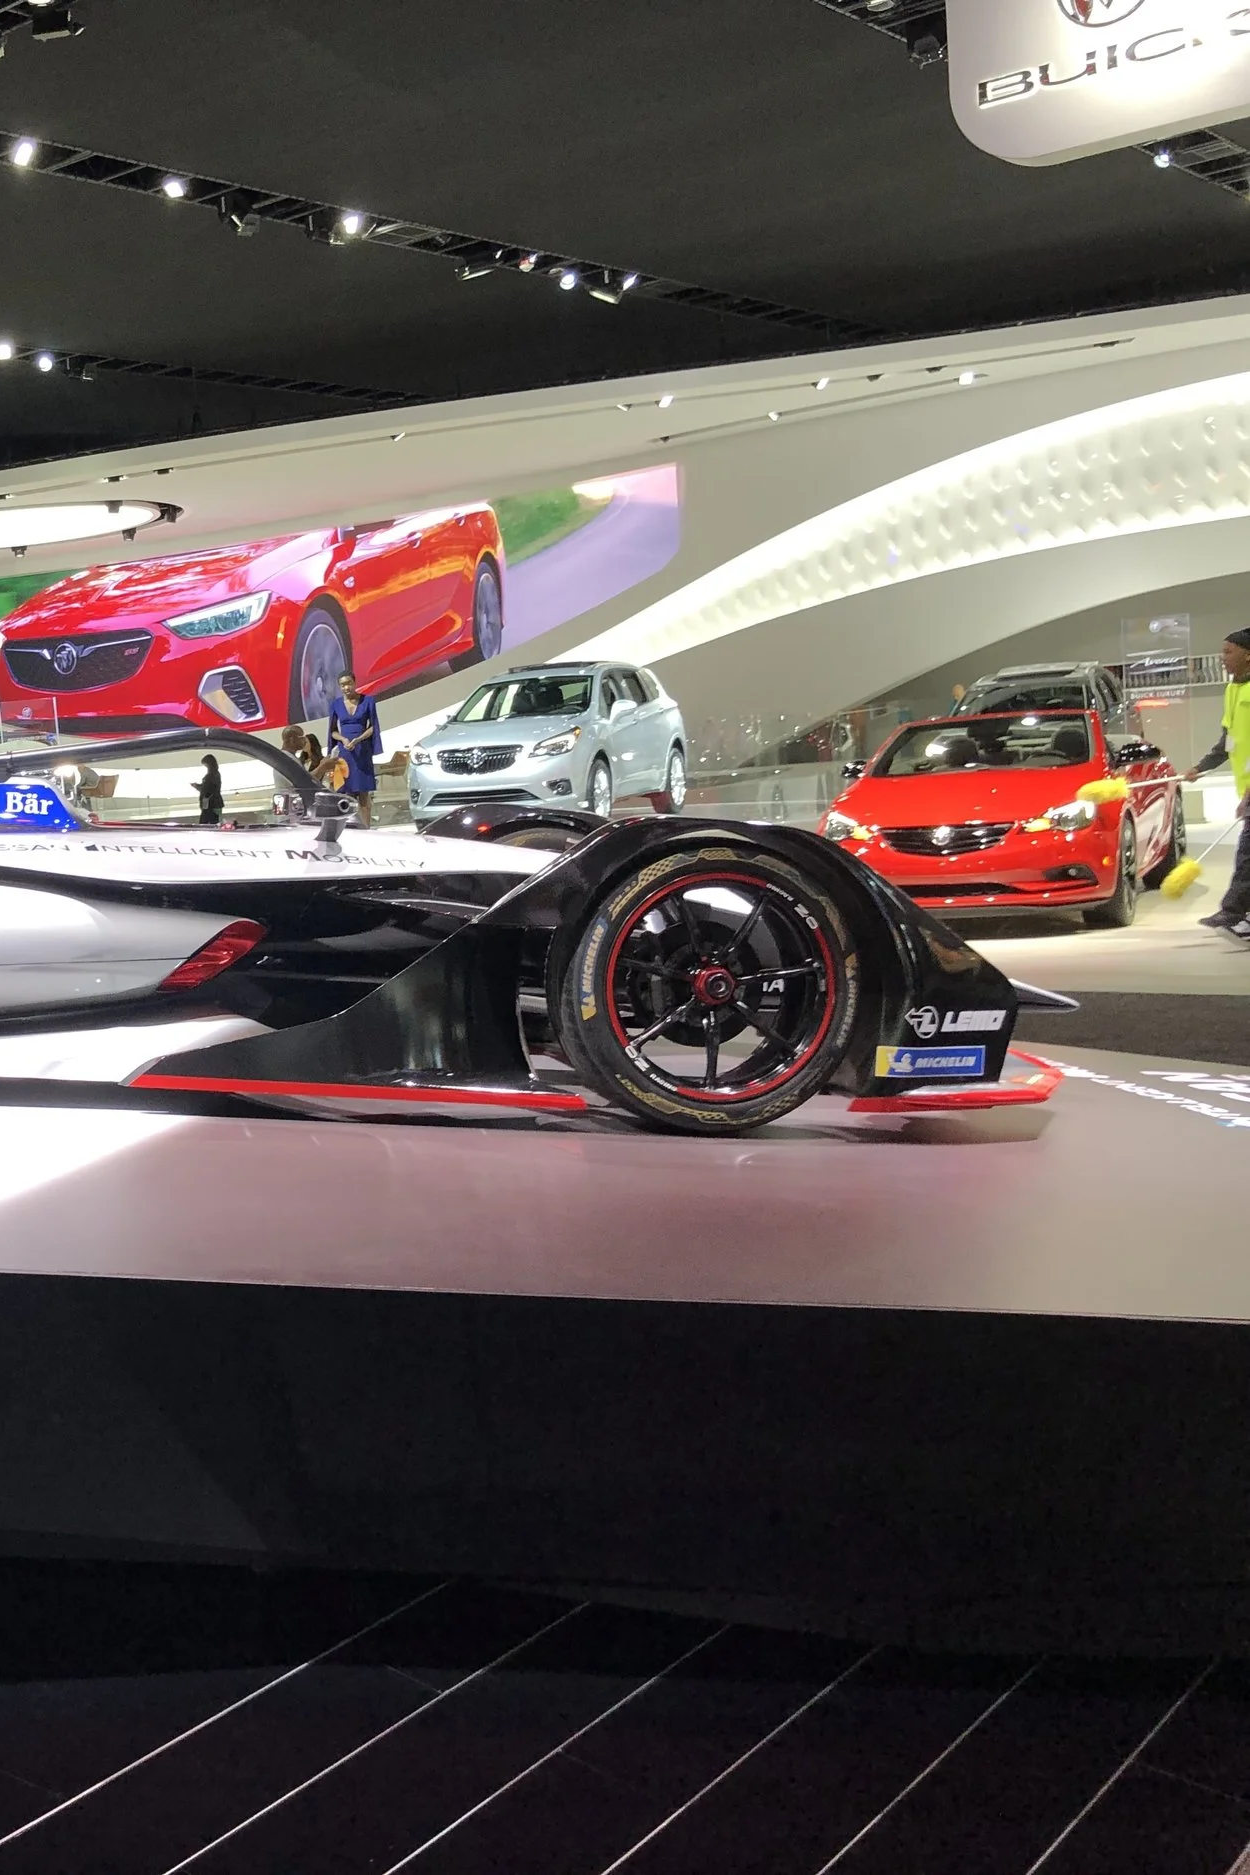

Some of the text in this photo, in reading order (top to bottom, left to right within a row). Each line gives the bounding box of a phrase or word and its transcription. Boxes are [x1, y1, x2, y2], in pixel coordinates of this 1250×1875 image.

[5, 792, 54, 815] Bär
[285, 849, 426, 869] MOBILITY
[581, 924, 605, 997] MICHELIN
[940, 1010, 1007, 1033] LEMO
[914, 1055, 977, 1069] MICHELIN
